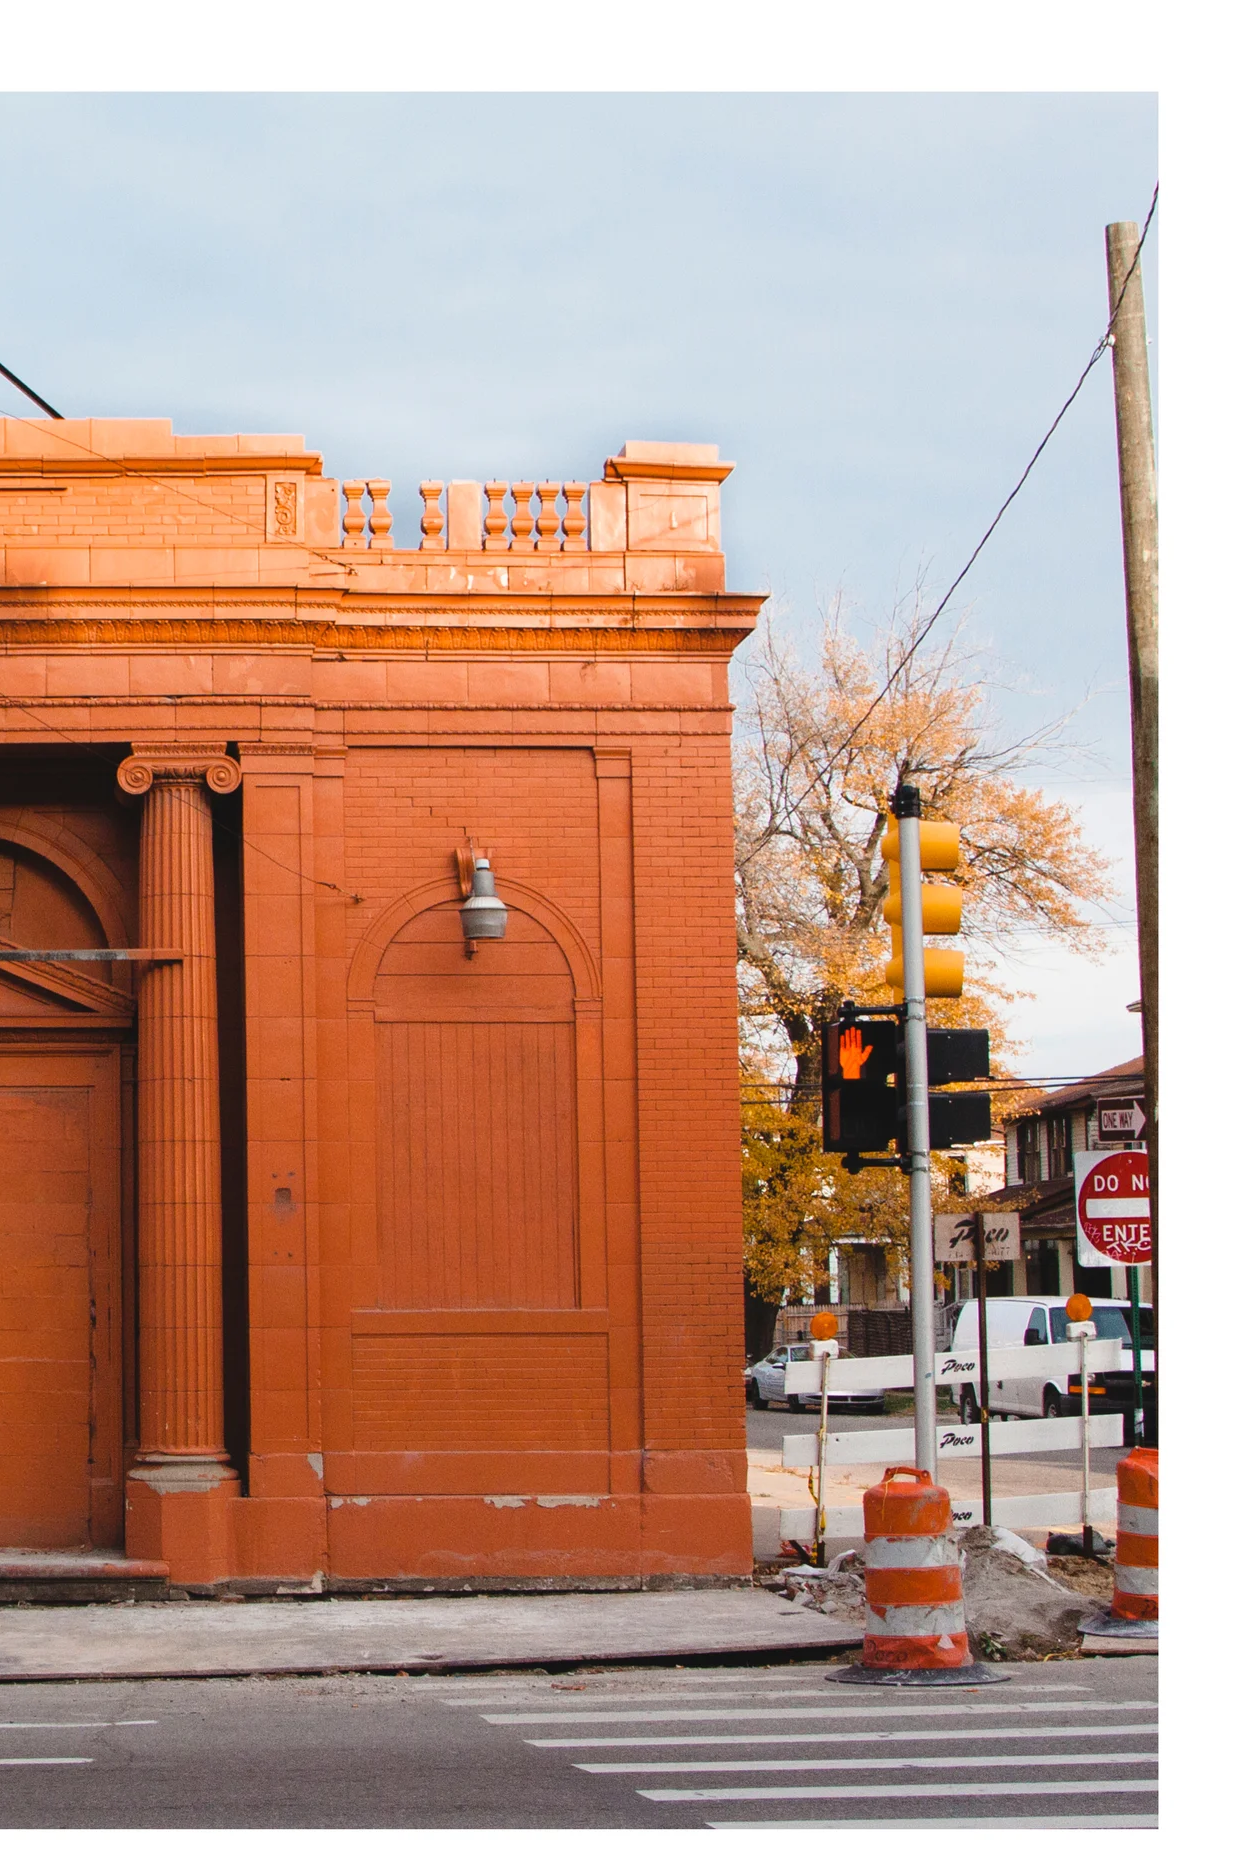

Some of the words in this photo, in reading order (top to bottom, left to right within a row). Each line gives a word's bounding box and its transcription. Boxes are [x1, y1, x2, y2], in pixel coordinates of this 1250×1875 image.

[1103, 1112, 1117, 1128] ONE
[1118, 1111, 1133, 1128] WAY
[1094, 1175, 1119, 1191] DO
[949, 1219, 1009, 1248] Pco
[1103, 1224, 1150, 1241] ENTE
[941, 1359, 975, 1374] Poco
[940, 1433, 974, 1448] Poco
[952, 1508, 973, 1521] oco
